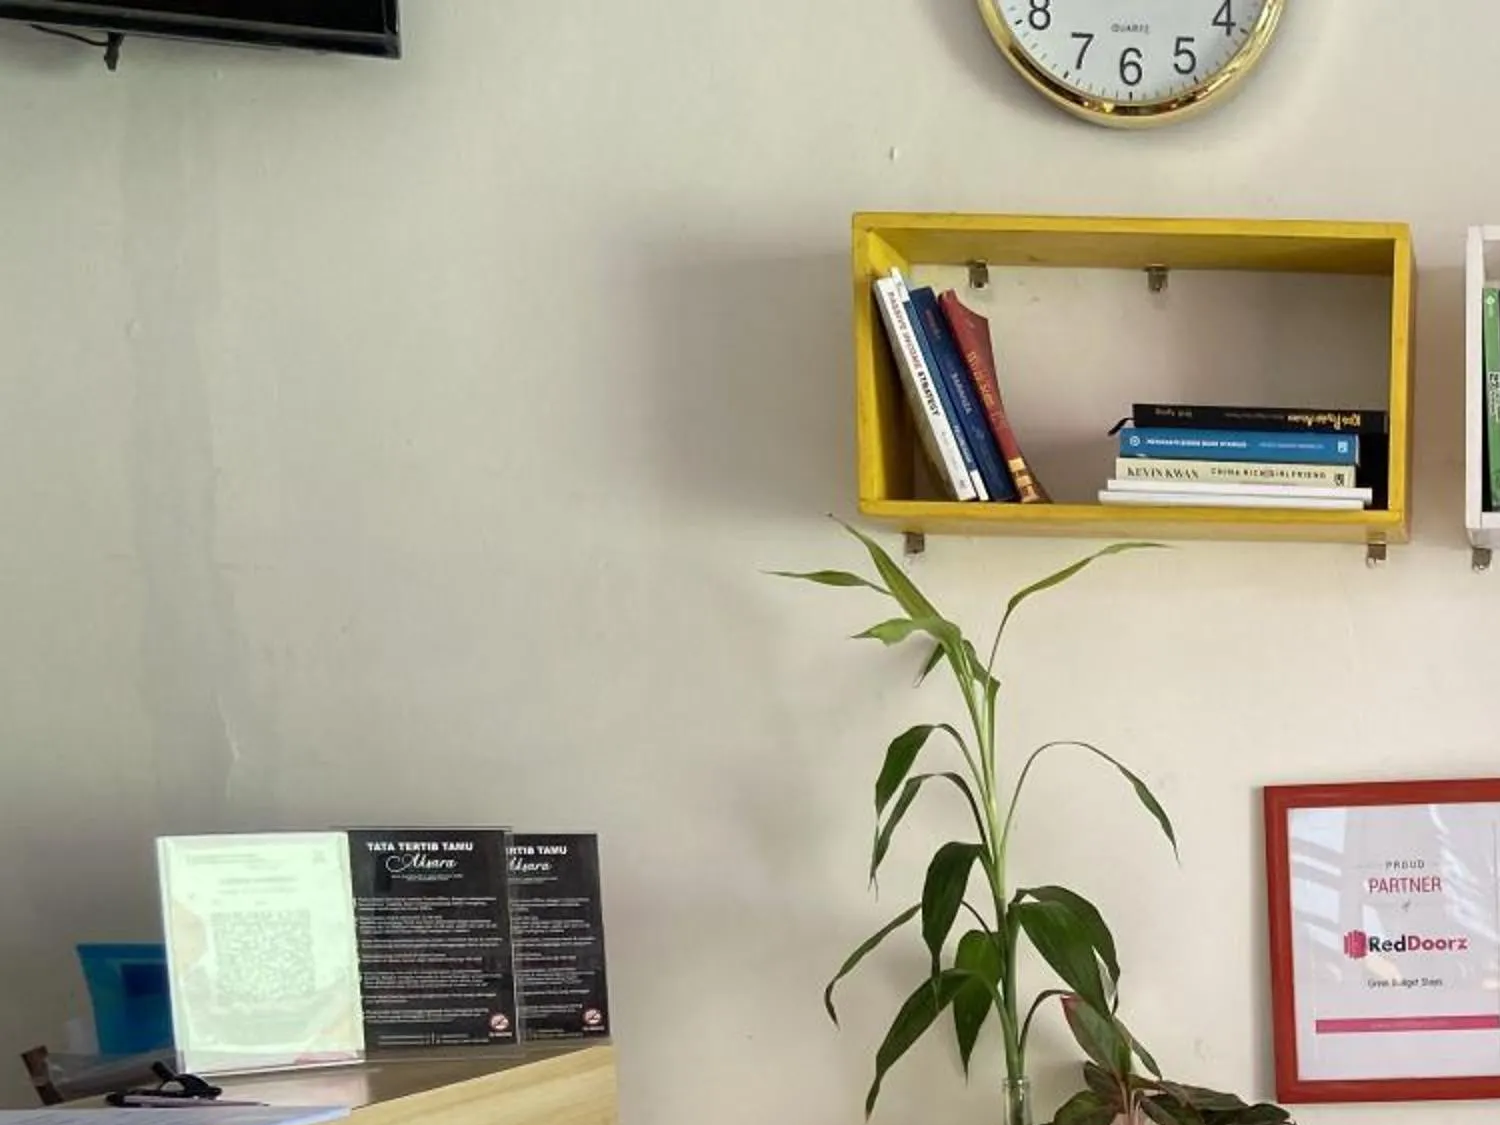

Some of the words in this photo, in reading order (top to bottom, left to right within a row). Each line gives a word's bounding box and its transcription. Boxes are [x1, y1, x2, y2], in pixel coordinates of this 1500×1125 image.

[1029, 0, 1051, 30] 8
[1212, 0, 1237, 36] 4
[1071, 33, 1094, 69] 7
[1173, 37, 1197, 75] 5
[1119, 48, 1143, 86] 6
[917, 371, 941, 416] STRATEGY
[1127, 467, 1164, 478] KEVIN
[1165, 468, 1199, 479] KWAN
[366, 841, 395, 851] TATA
[398, 841, 439, 851] TERTIB
[441, 841, 474, 851] TAMU
[507, 845, 536, 855] RTIB
[537, 845, 568, 855] TAMU
[1385, 860, 1425, 870] PROUD
[1368, 876, 1442, 894] PARTNER
[1368, 934, 1469, 953] RedDoorz
